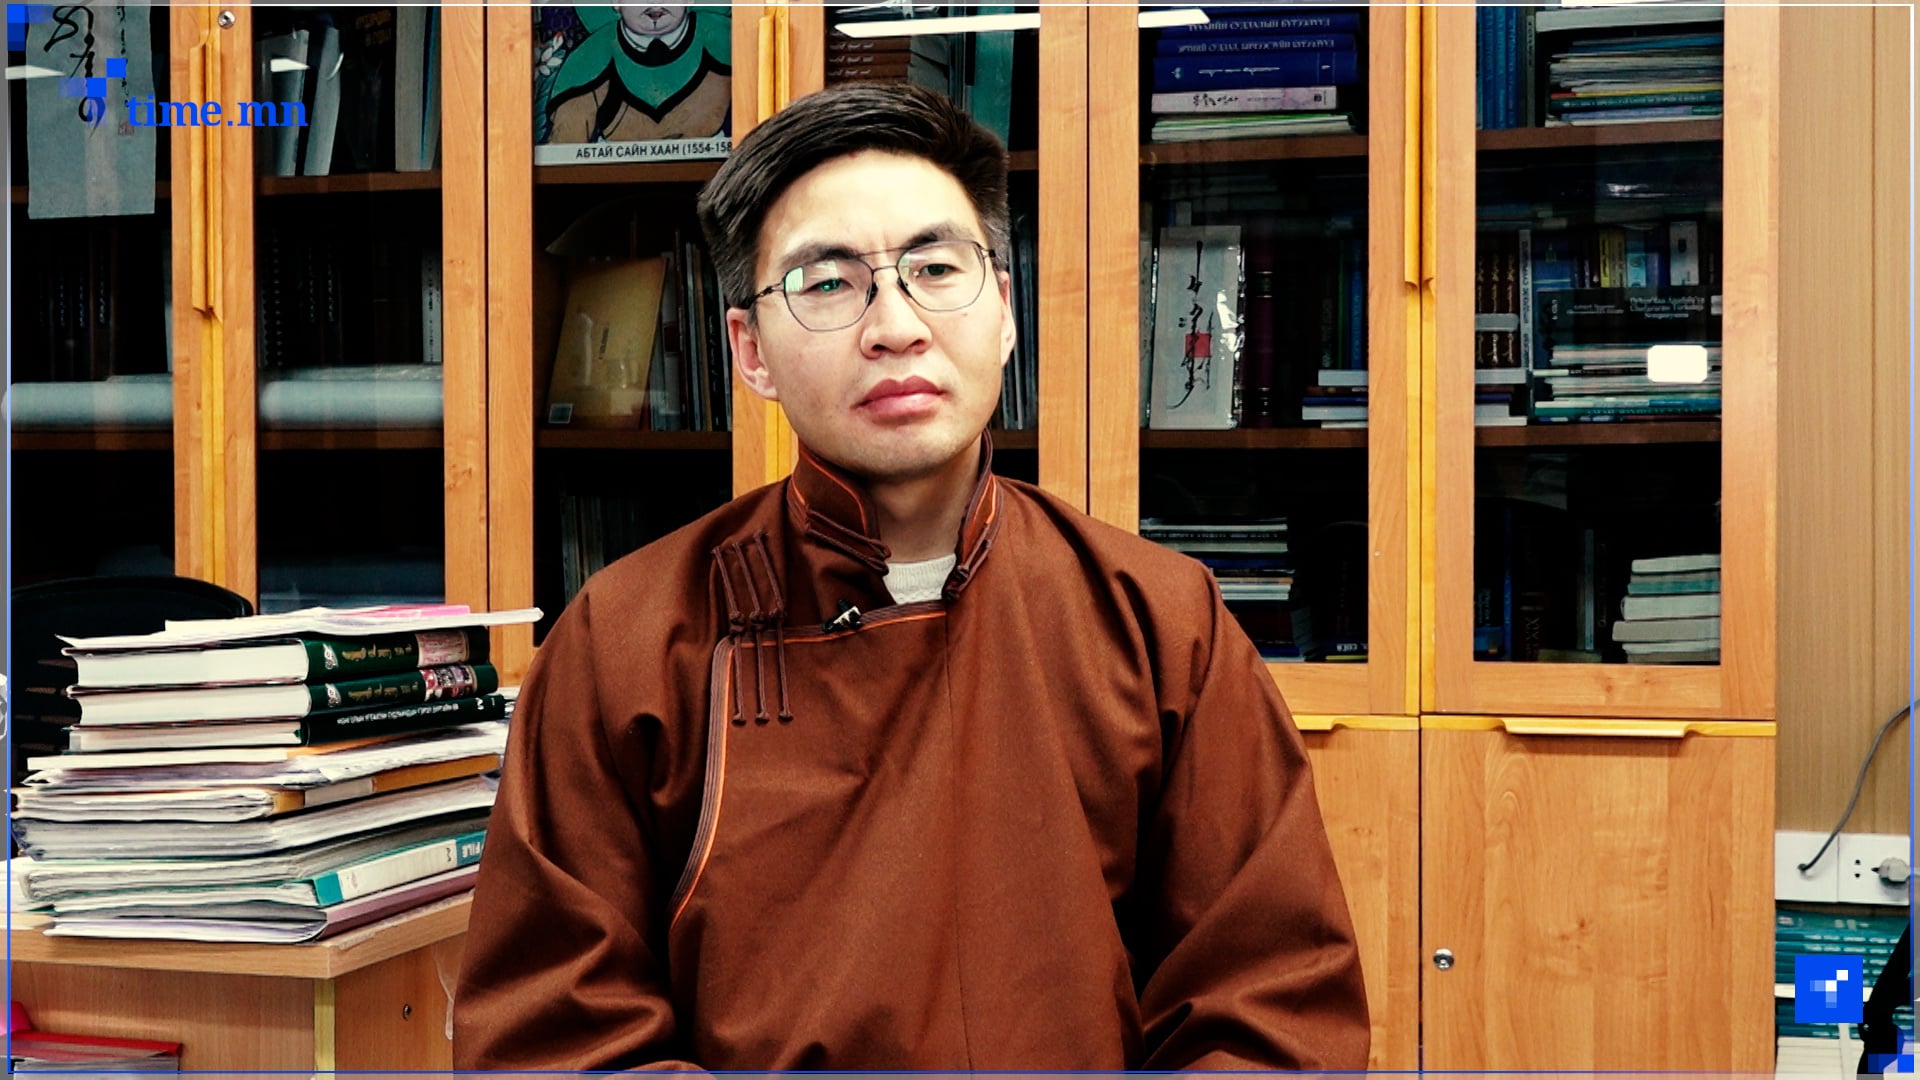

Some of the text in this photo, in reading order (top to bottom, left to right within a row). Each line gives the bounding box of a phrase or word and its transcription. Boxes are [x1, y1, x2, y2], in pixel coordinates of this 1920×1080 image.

[575, 144, 613, 160] АБТАЙ
[615, 143, 648, 158] САЙН
[650, 142, 680, 157] ХААН
